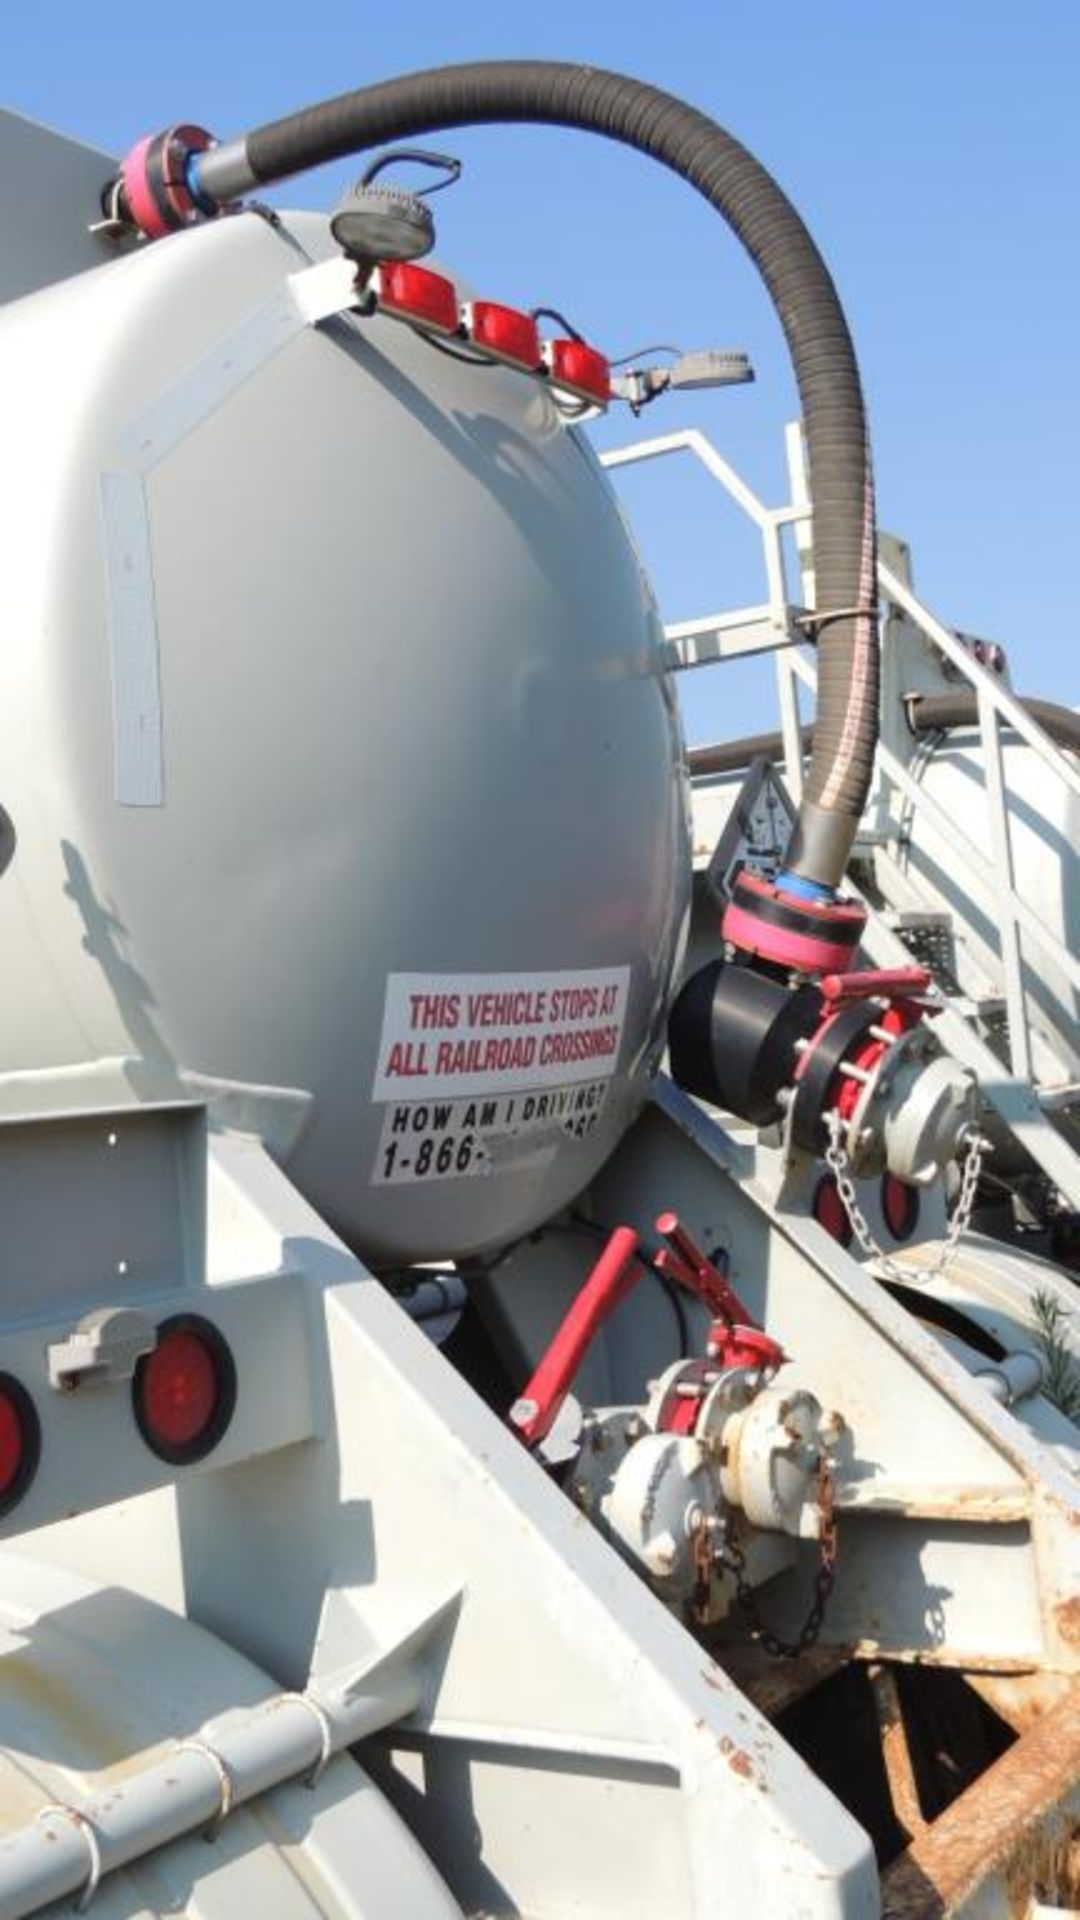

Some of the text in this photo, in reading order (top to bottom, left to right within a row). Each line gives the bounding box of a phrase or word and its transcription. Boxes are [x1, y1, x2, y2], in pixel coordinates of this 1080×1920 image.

[409, 985, 618, 1029] THIS VEHICLE STOPS AT
[385, 1025, 618, 1077] ALL RAILROAD CROSSINGS
[391, 1105, 453, 1133] HOW
[463, 1102, 497, 1128] AM
[505, 1099, 515, 1122] I
